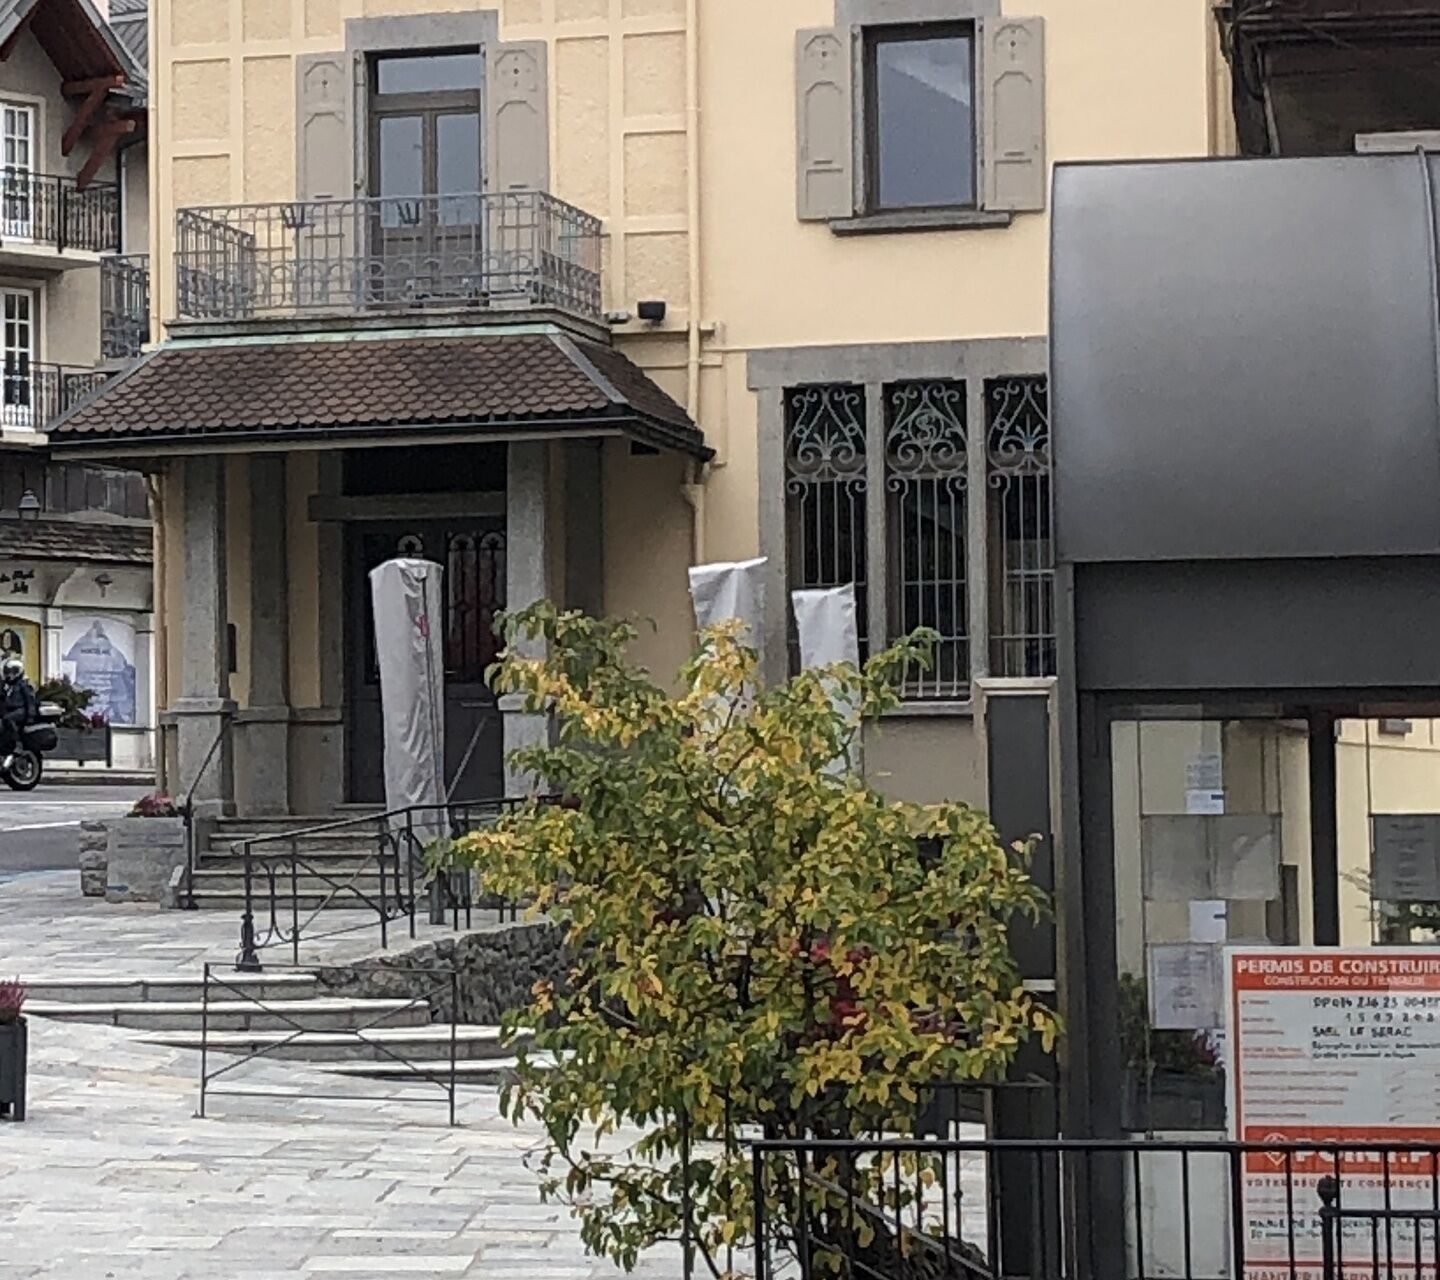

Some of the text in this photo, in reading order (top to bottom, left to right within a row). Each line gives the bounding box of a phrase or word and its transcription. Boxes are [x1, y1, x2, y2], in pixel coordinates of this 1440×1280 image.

[1237, 960, 1304, 973] PERMIS
[1310, 960, 1332, 973] DE
[1264, 976, 1349, 986] CONSTRUCTION
[1352, 976, 1367, 986] OU
